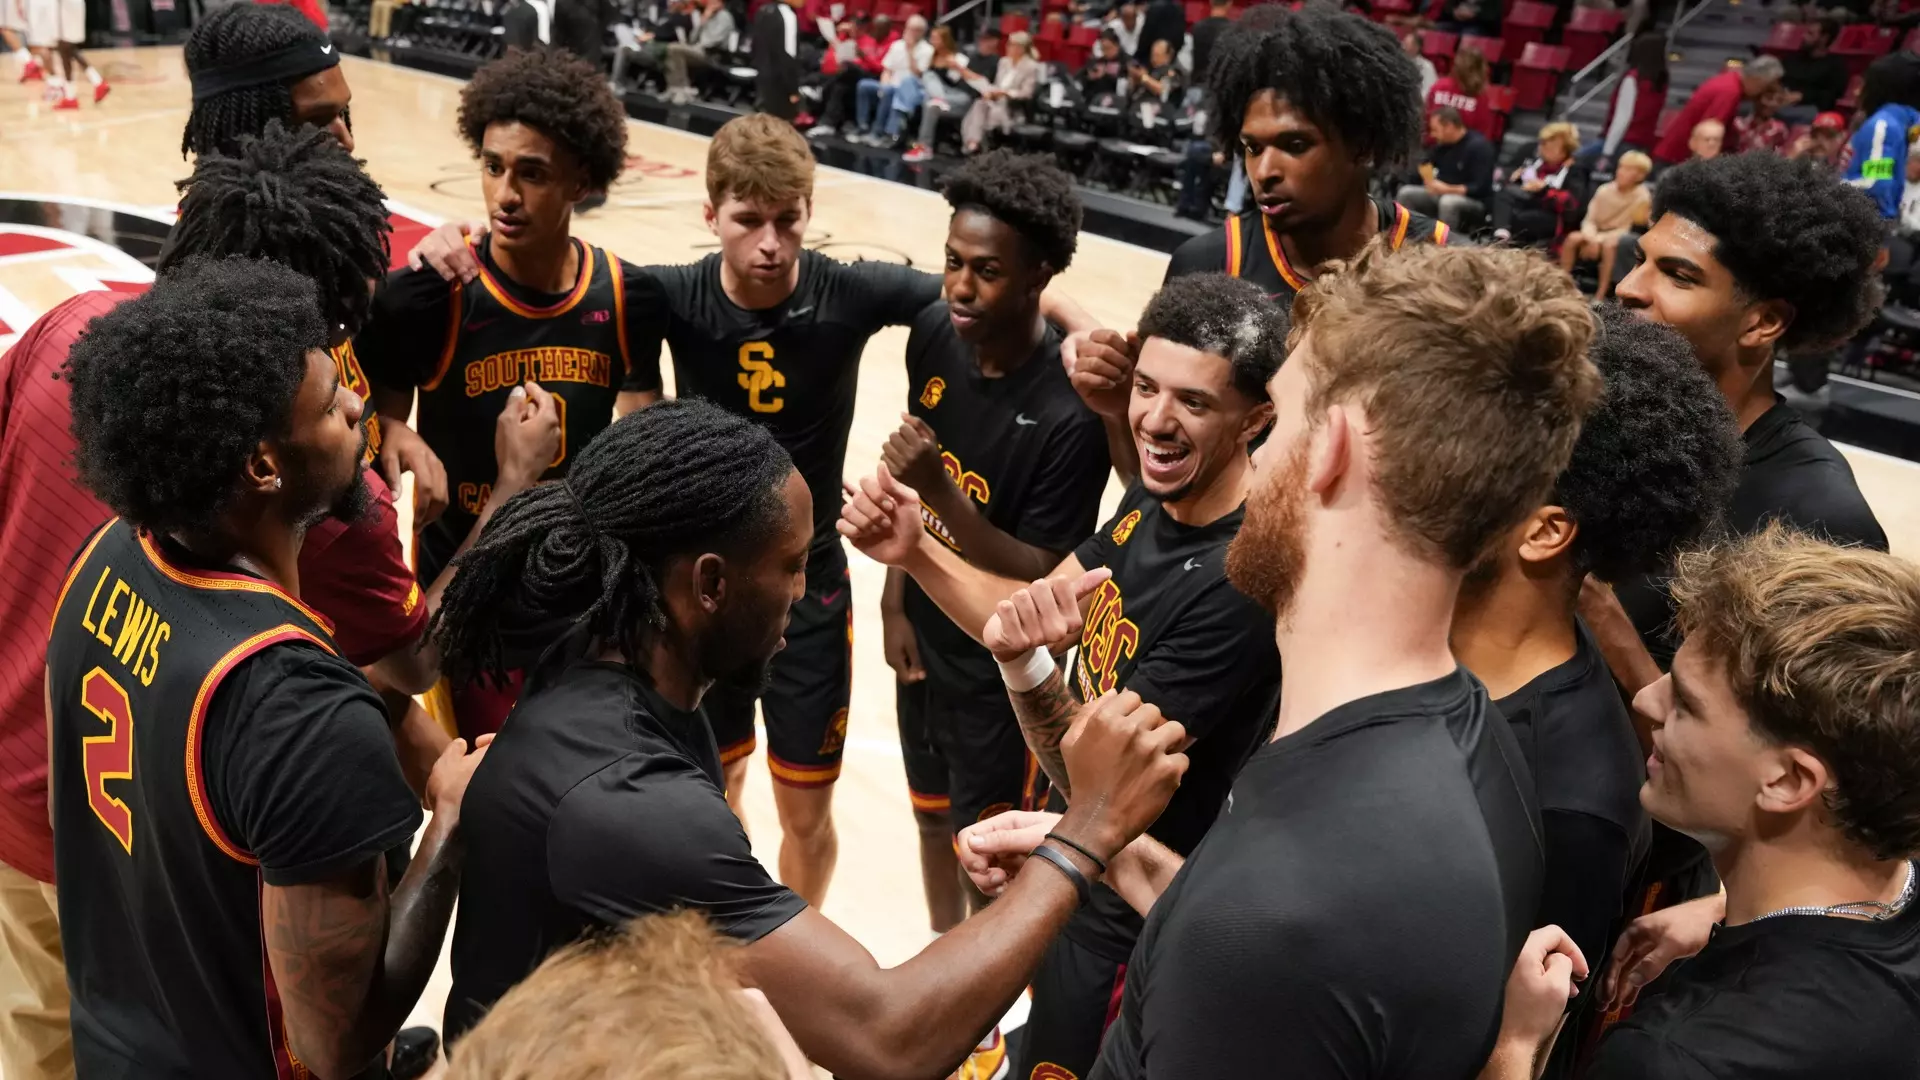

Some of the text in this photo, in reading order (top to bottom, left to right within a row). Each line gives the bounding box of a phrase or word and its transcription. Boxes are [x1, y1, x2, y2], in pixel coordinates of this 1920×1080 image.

[465, 346, 611, 398] SOUTHERN
[737, 341, 785, 413] SC
[82, 565, 170, 687] LEWIS
[81, 666, 133, 856] 2
